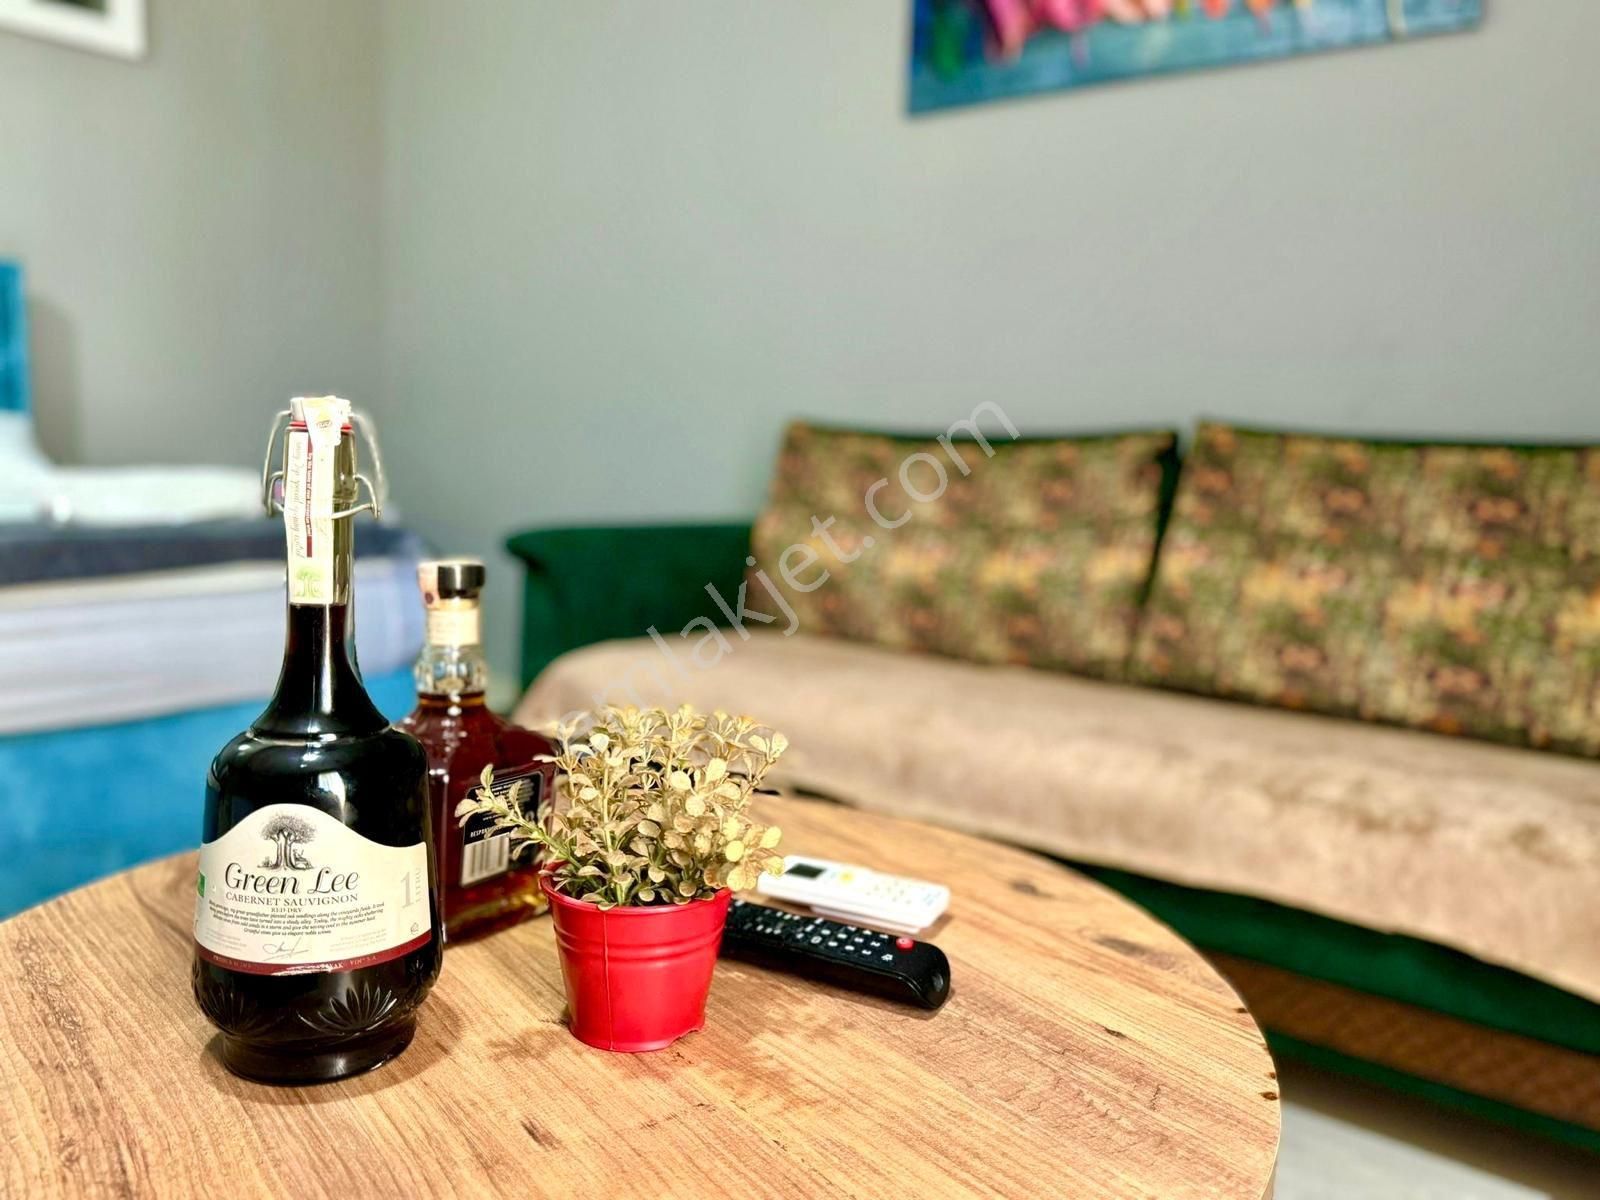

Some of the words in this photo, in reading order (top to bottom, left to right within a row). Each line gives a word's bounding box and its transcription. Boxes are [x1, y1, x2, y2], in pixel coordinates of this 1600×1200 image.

[225, 862, 299, 895] Green
[307, 867, 360, 894] Lee
[401, 871, 414, 909] 1
[225, 892, 281, 907] CABERNET
[284, 893, 358, 907] SAUVIGNON
